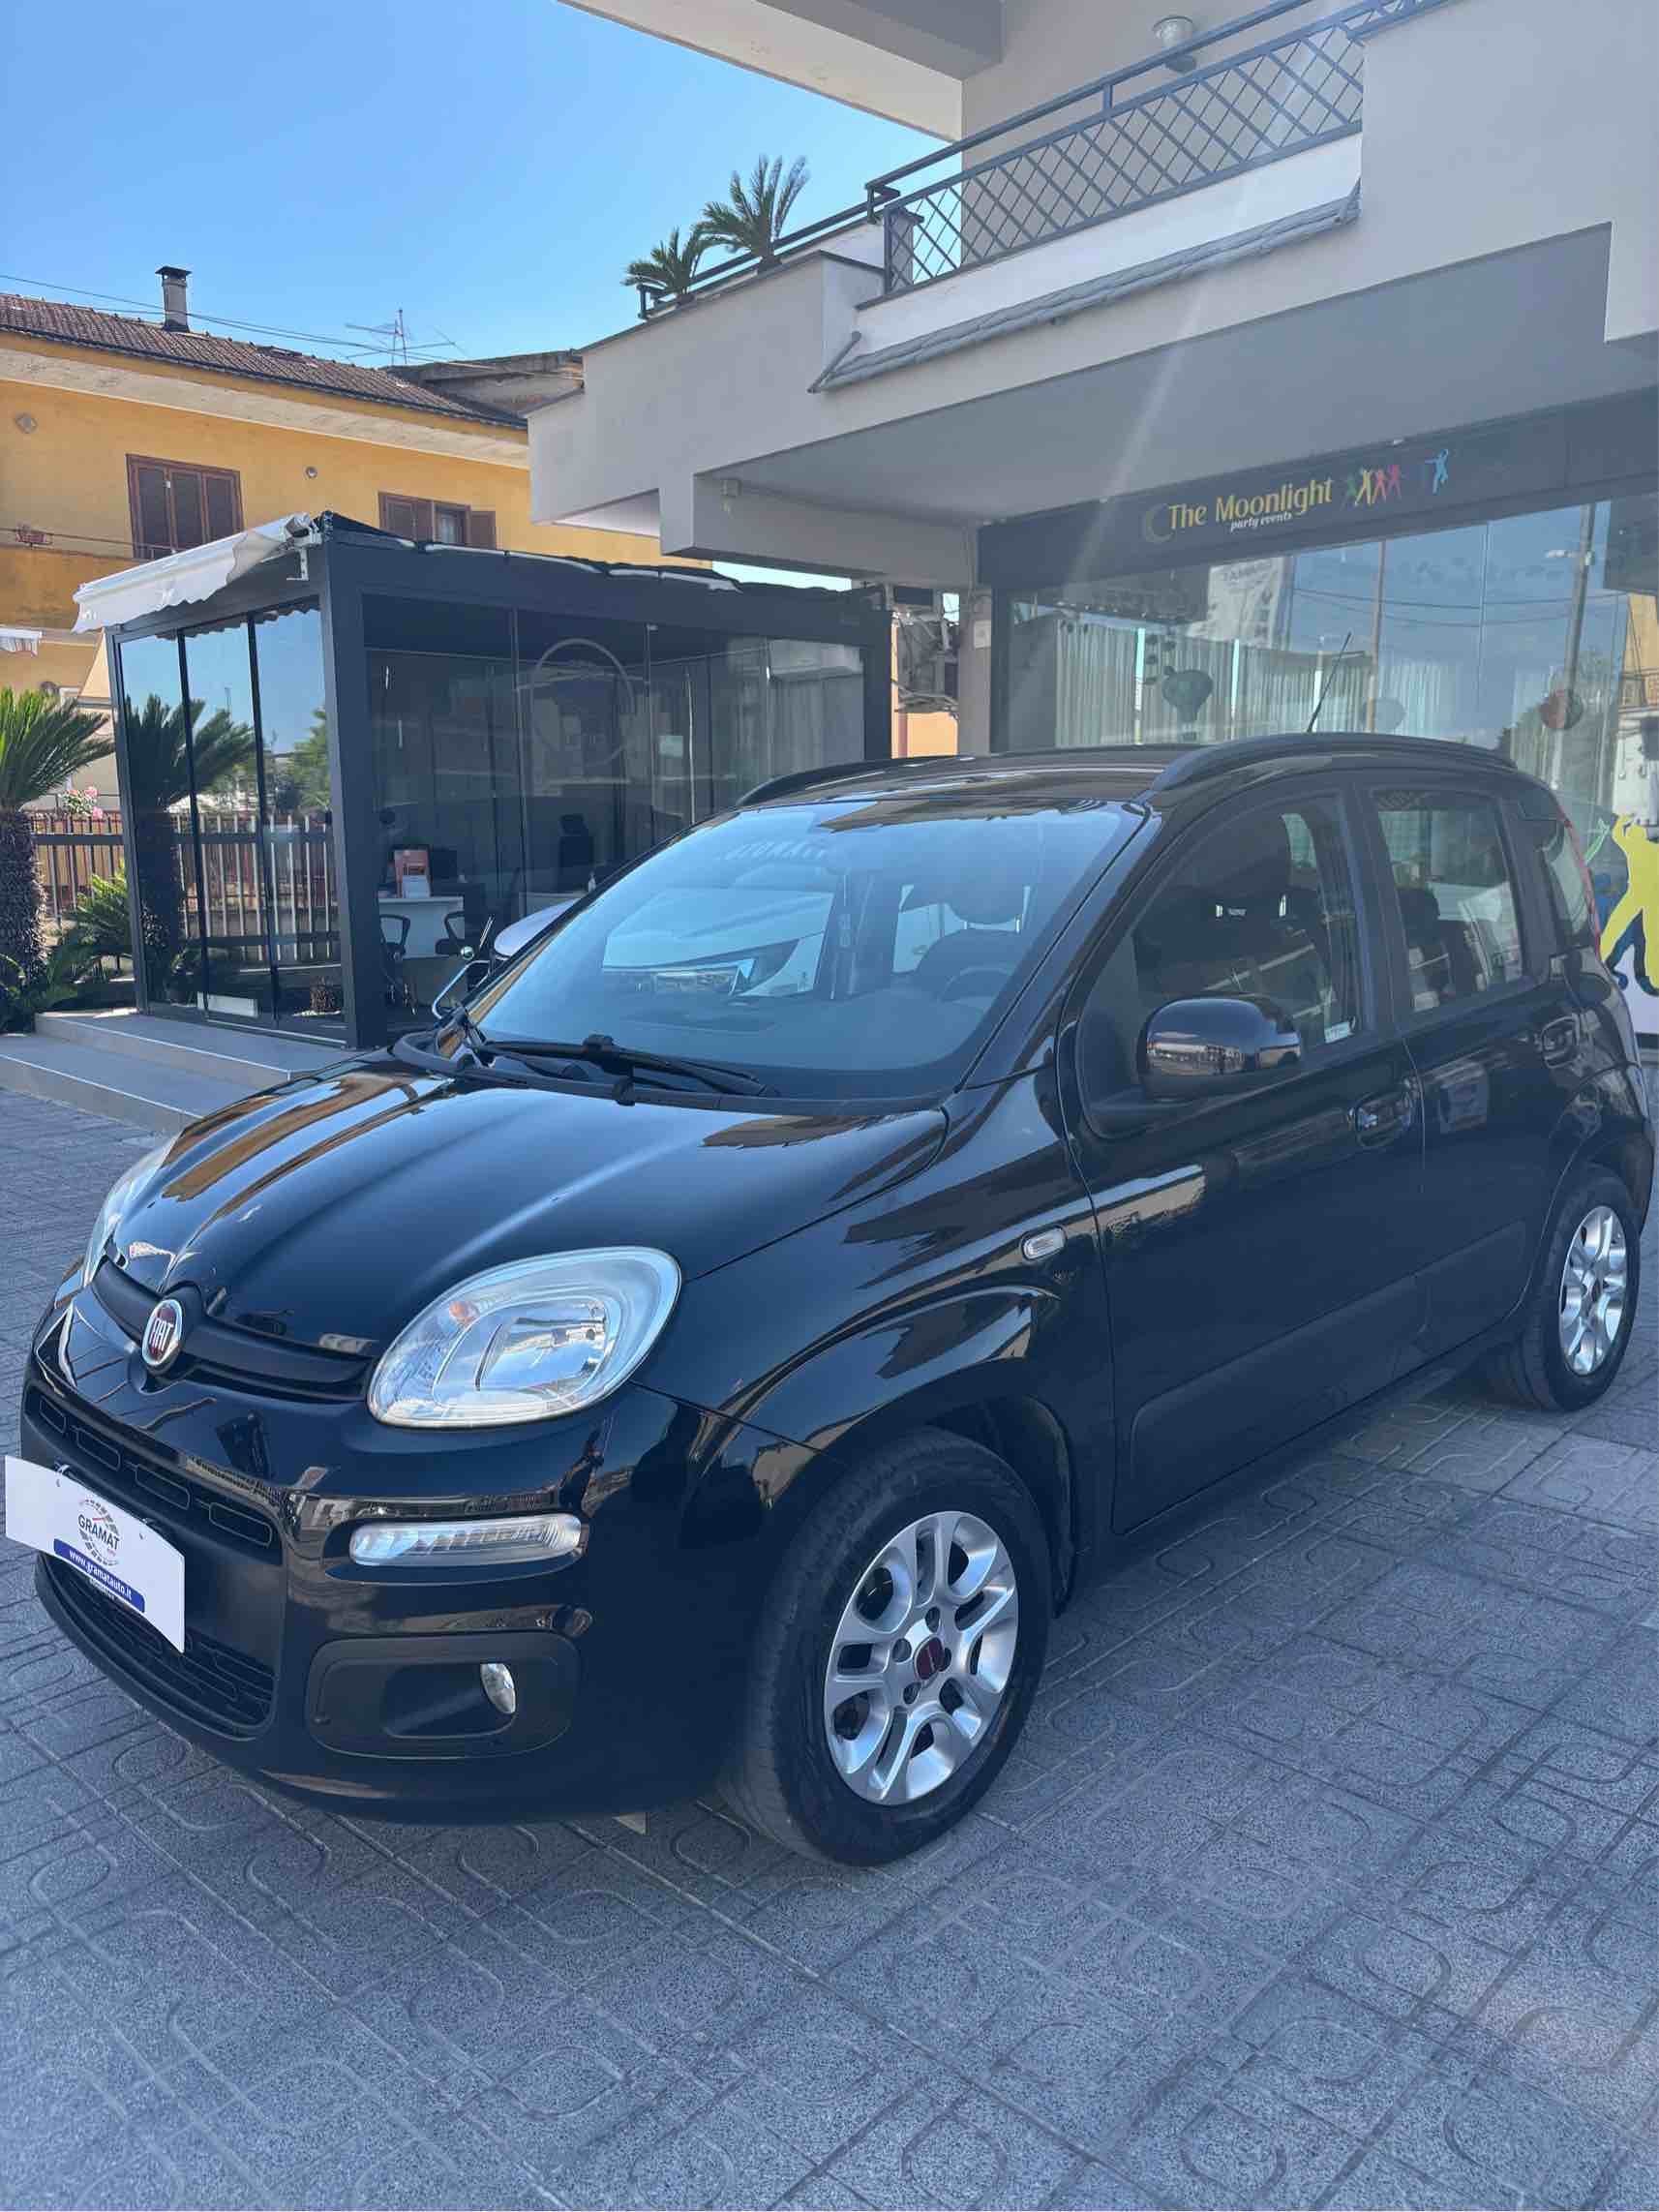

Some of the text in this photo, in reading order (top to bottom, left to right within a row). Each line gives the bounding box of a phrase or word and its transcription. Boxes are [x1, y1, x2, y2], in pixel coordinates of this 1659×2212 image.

[1168, 476, 1334, 530] The Moonlight
[1230, 511, 1292, 531] party events
[148, 1318, 174, 1352] FIAT
[77, 1514, 120, 1551] GRAMAT
[69, 1549, 133, 1602] www.gramatauto.it
